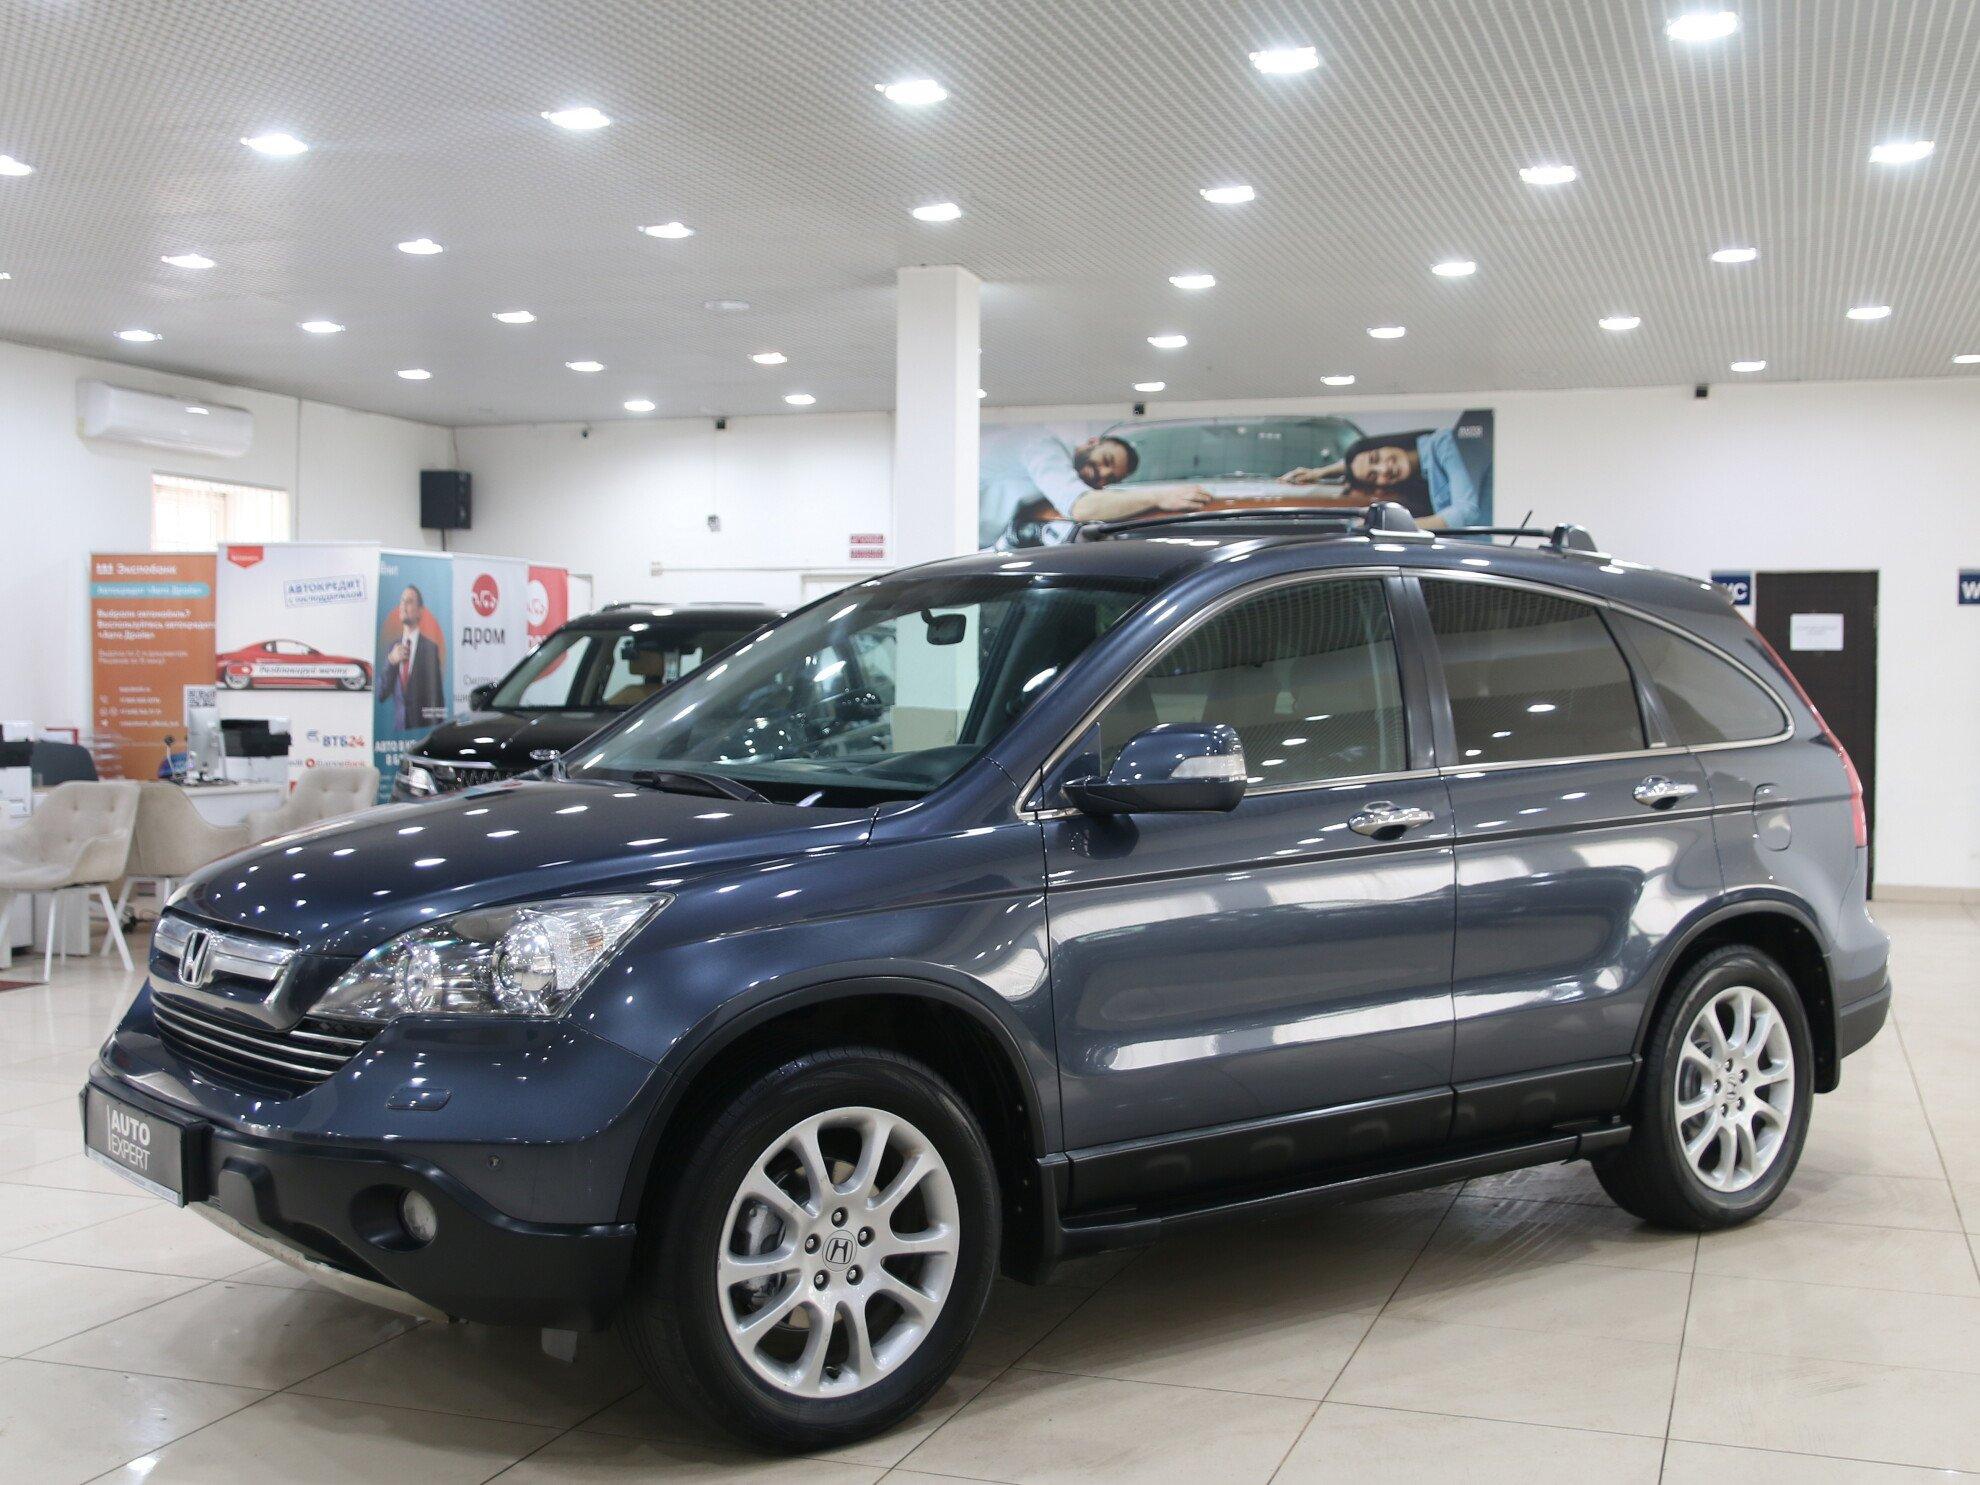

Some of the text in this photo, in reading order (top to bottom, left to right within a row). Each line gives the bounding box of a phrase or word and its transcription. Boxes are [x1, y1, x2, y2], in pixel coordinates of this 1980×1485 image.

[288, 579, 361, 594] АВТОКРЕДИТ
[1961, 580, 1980, 600] W
[322, 734, 365, 748] ВТБ24
[111, 1109, 151, 1146] AUTO
[111, 1133, 151, 1171] EXPERT
